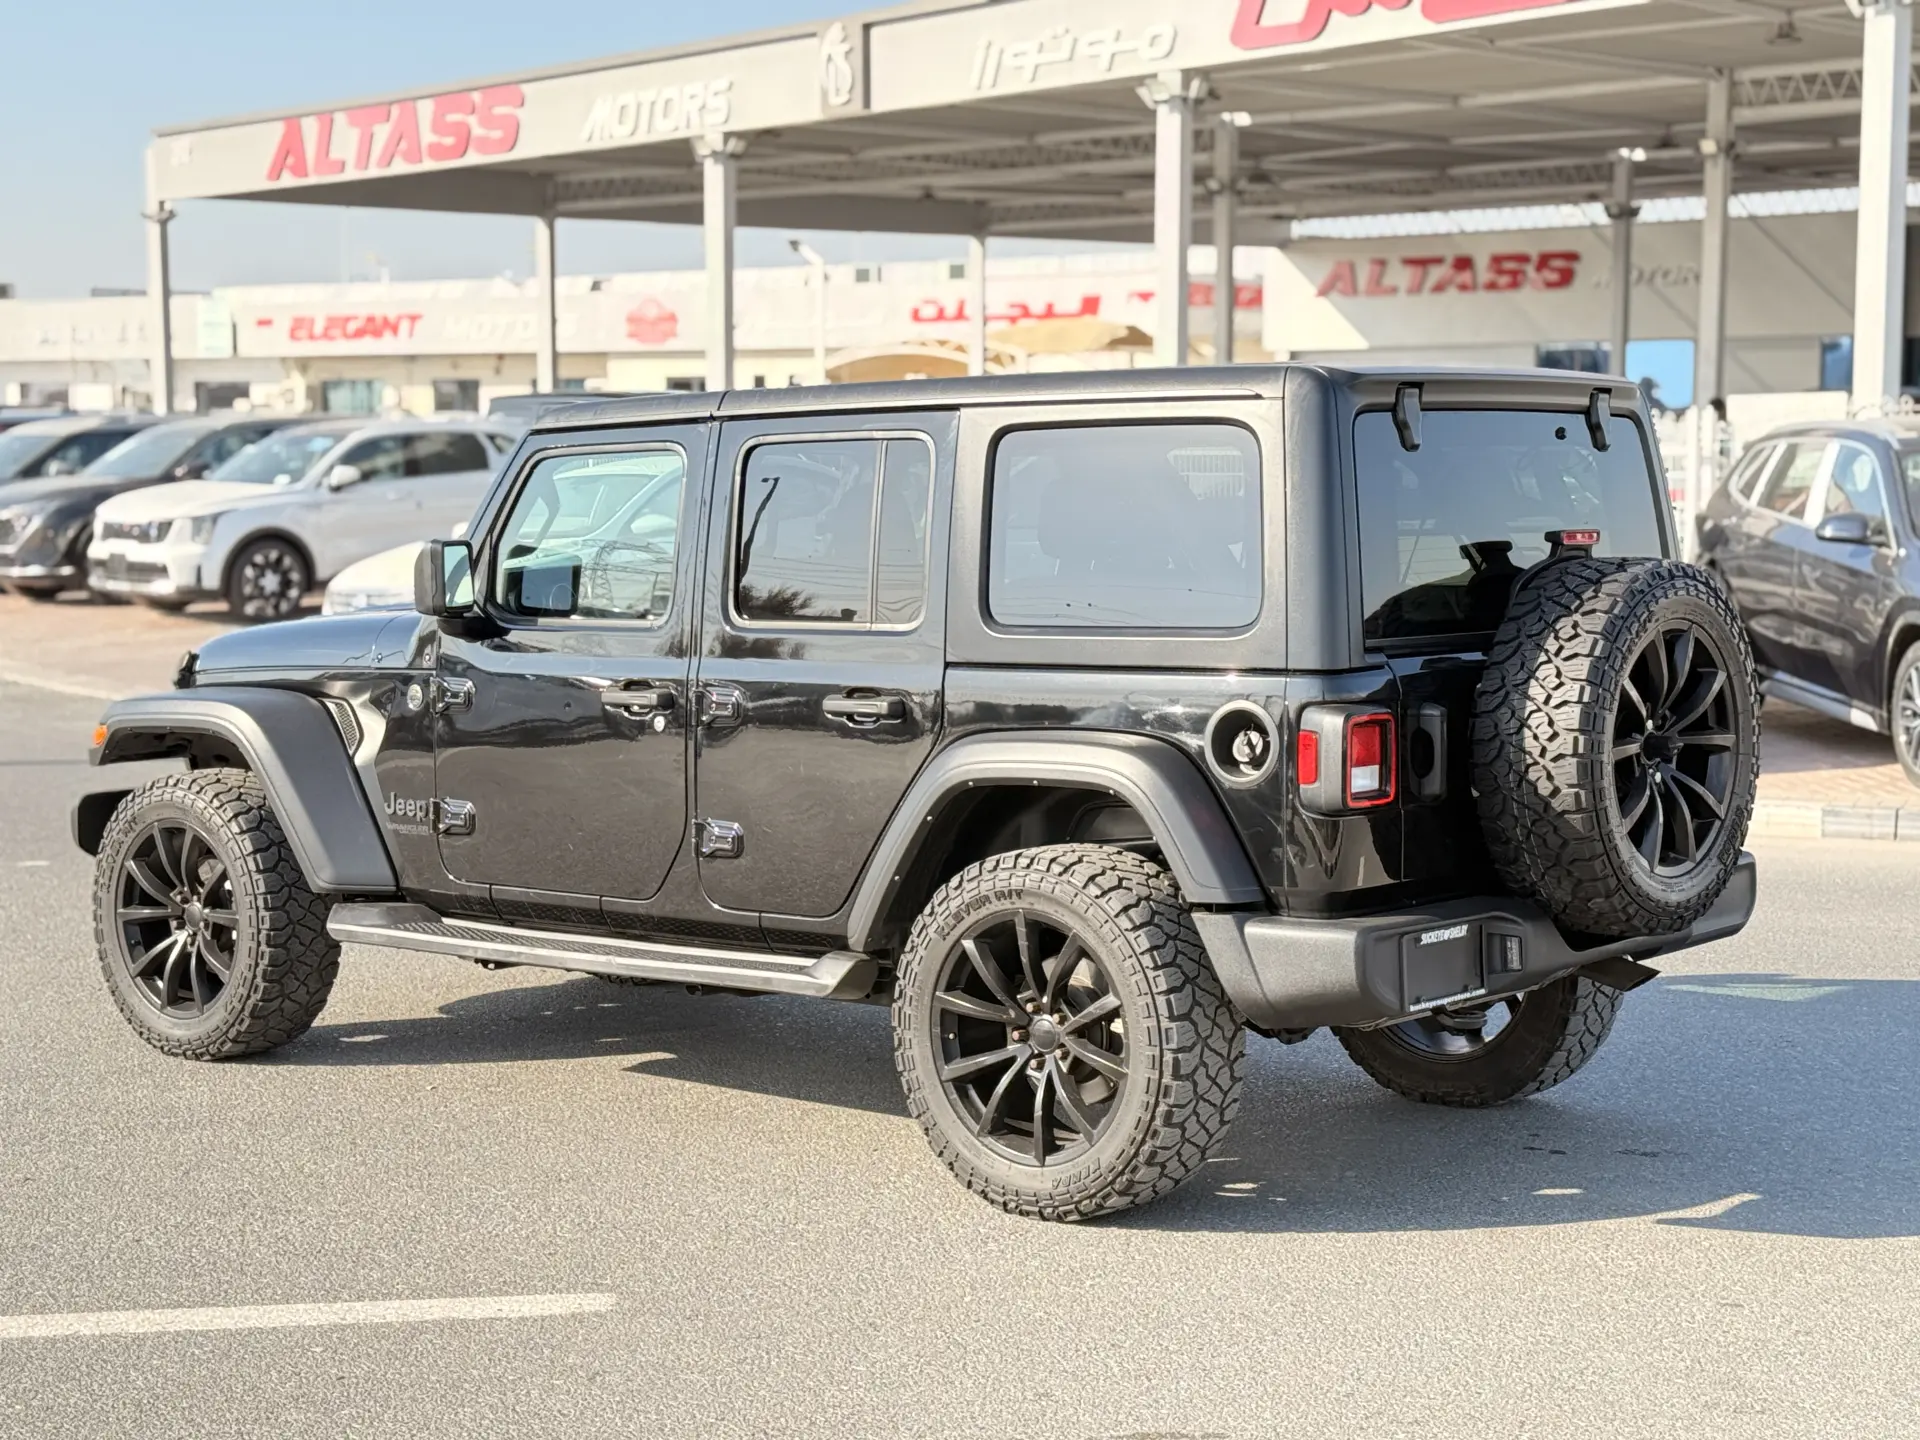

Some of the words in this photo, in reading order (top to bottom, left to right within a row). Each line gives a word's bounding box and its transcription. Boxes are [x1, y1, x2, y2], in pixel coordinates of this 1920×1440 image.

[266, 84, 526, 182] ALTASS
[580, 79, 736, 142] MOTORS
[1315, 249, 1582, 299] ALTASS
[289, 313, 423, 343] ELEGANT
[384, 791, 428, 822] Jeep
[935, 894, 992, 941] KLEVER
